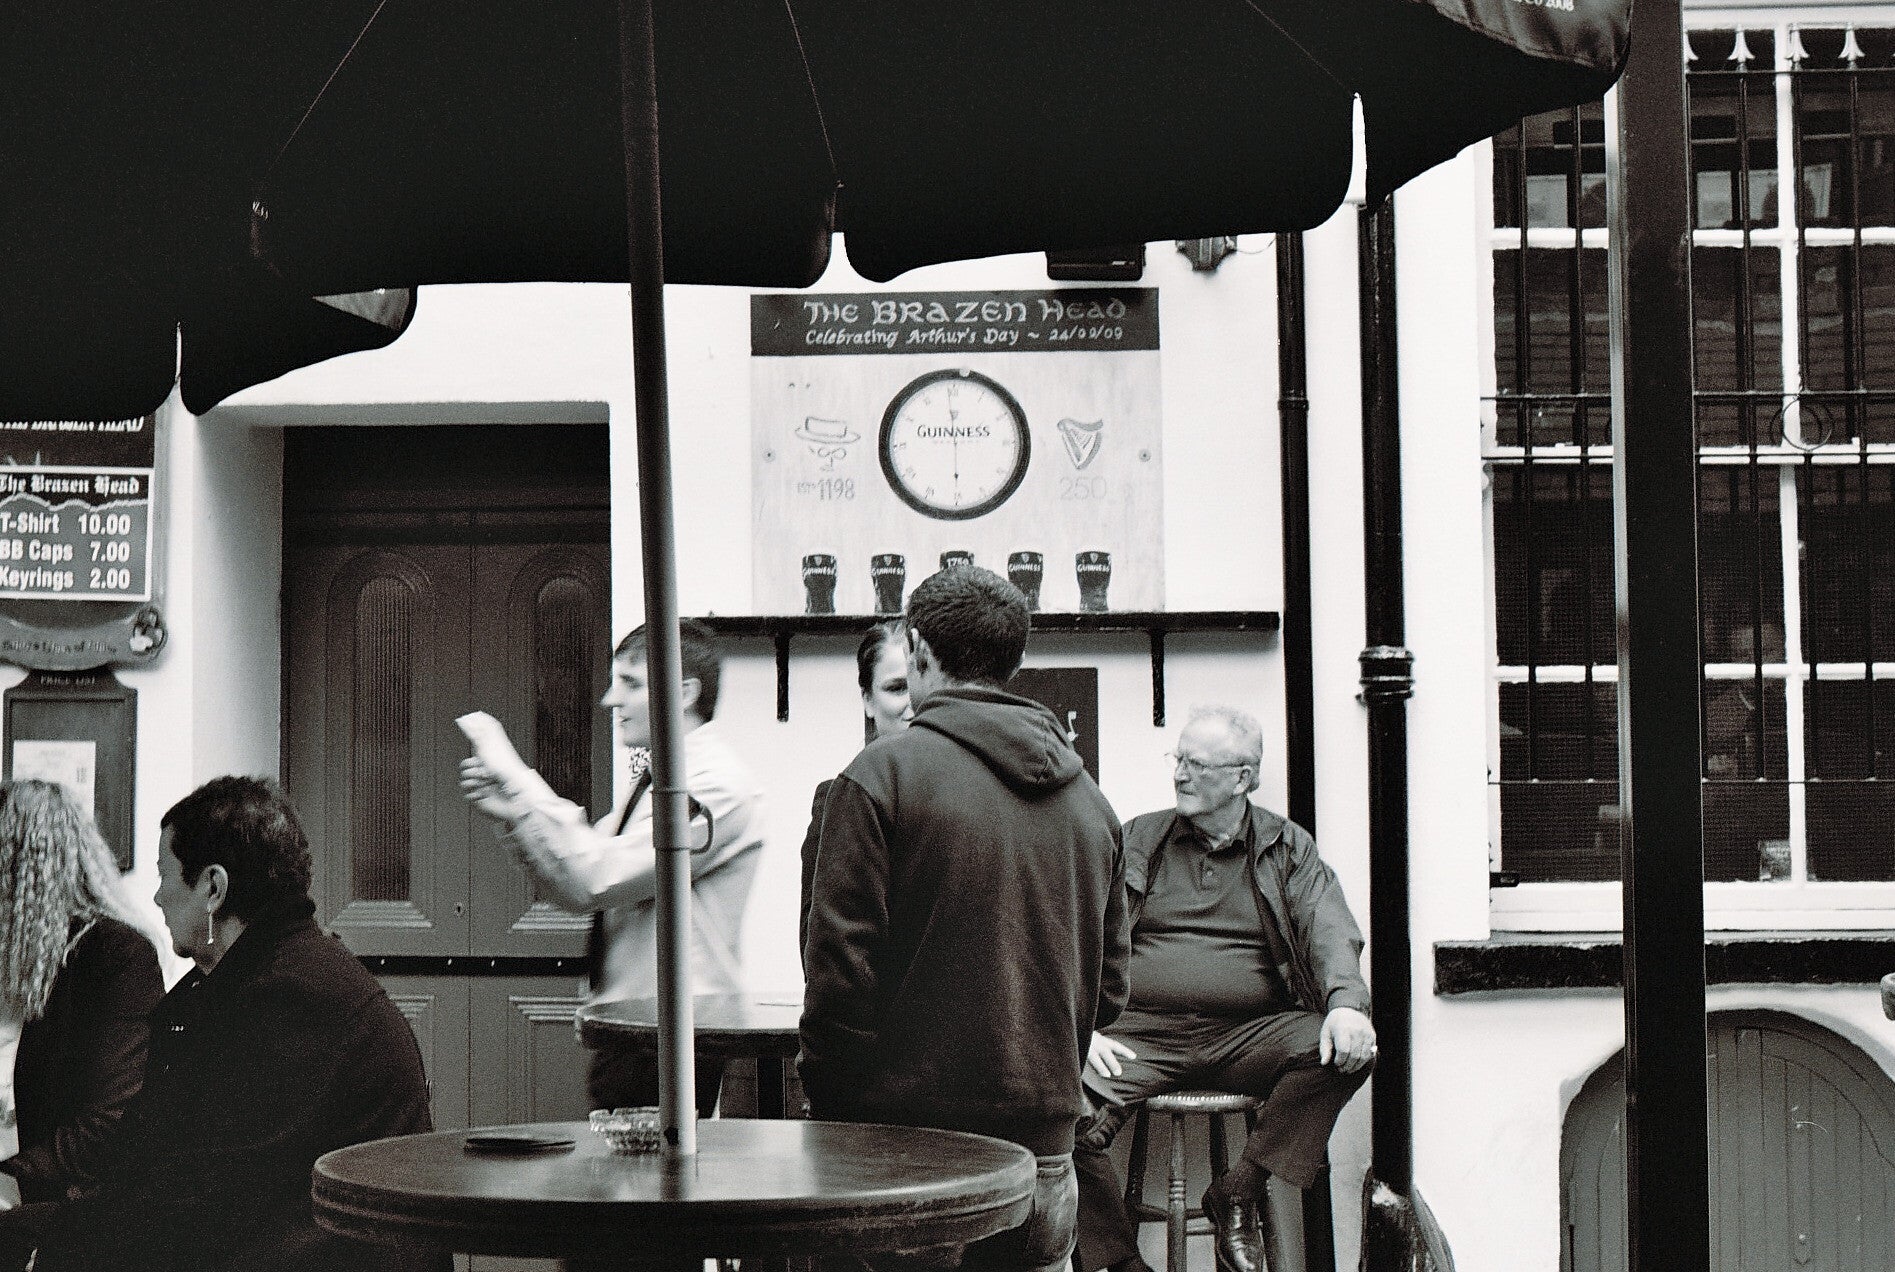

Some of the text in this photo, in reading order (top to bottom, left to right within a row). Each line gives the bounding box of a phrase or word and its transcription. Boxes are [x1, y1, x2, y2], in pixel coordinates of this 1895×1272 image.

[805, 327, 899, 349] Celebrating
[905, 326, 976, 345] Arthur's
[983, 327, 1019, 346] Day
[0, 474, 140, 498] The Brazen Head
[818, 478, 855, 501] 1198
[0, 511, 131, 535] T-Shirt 10.00
[29, 539, 73, 565] Caps
[90, 541, 130, 562] 7.00
[0, 565, 131, 592] Keyrings 2.00
